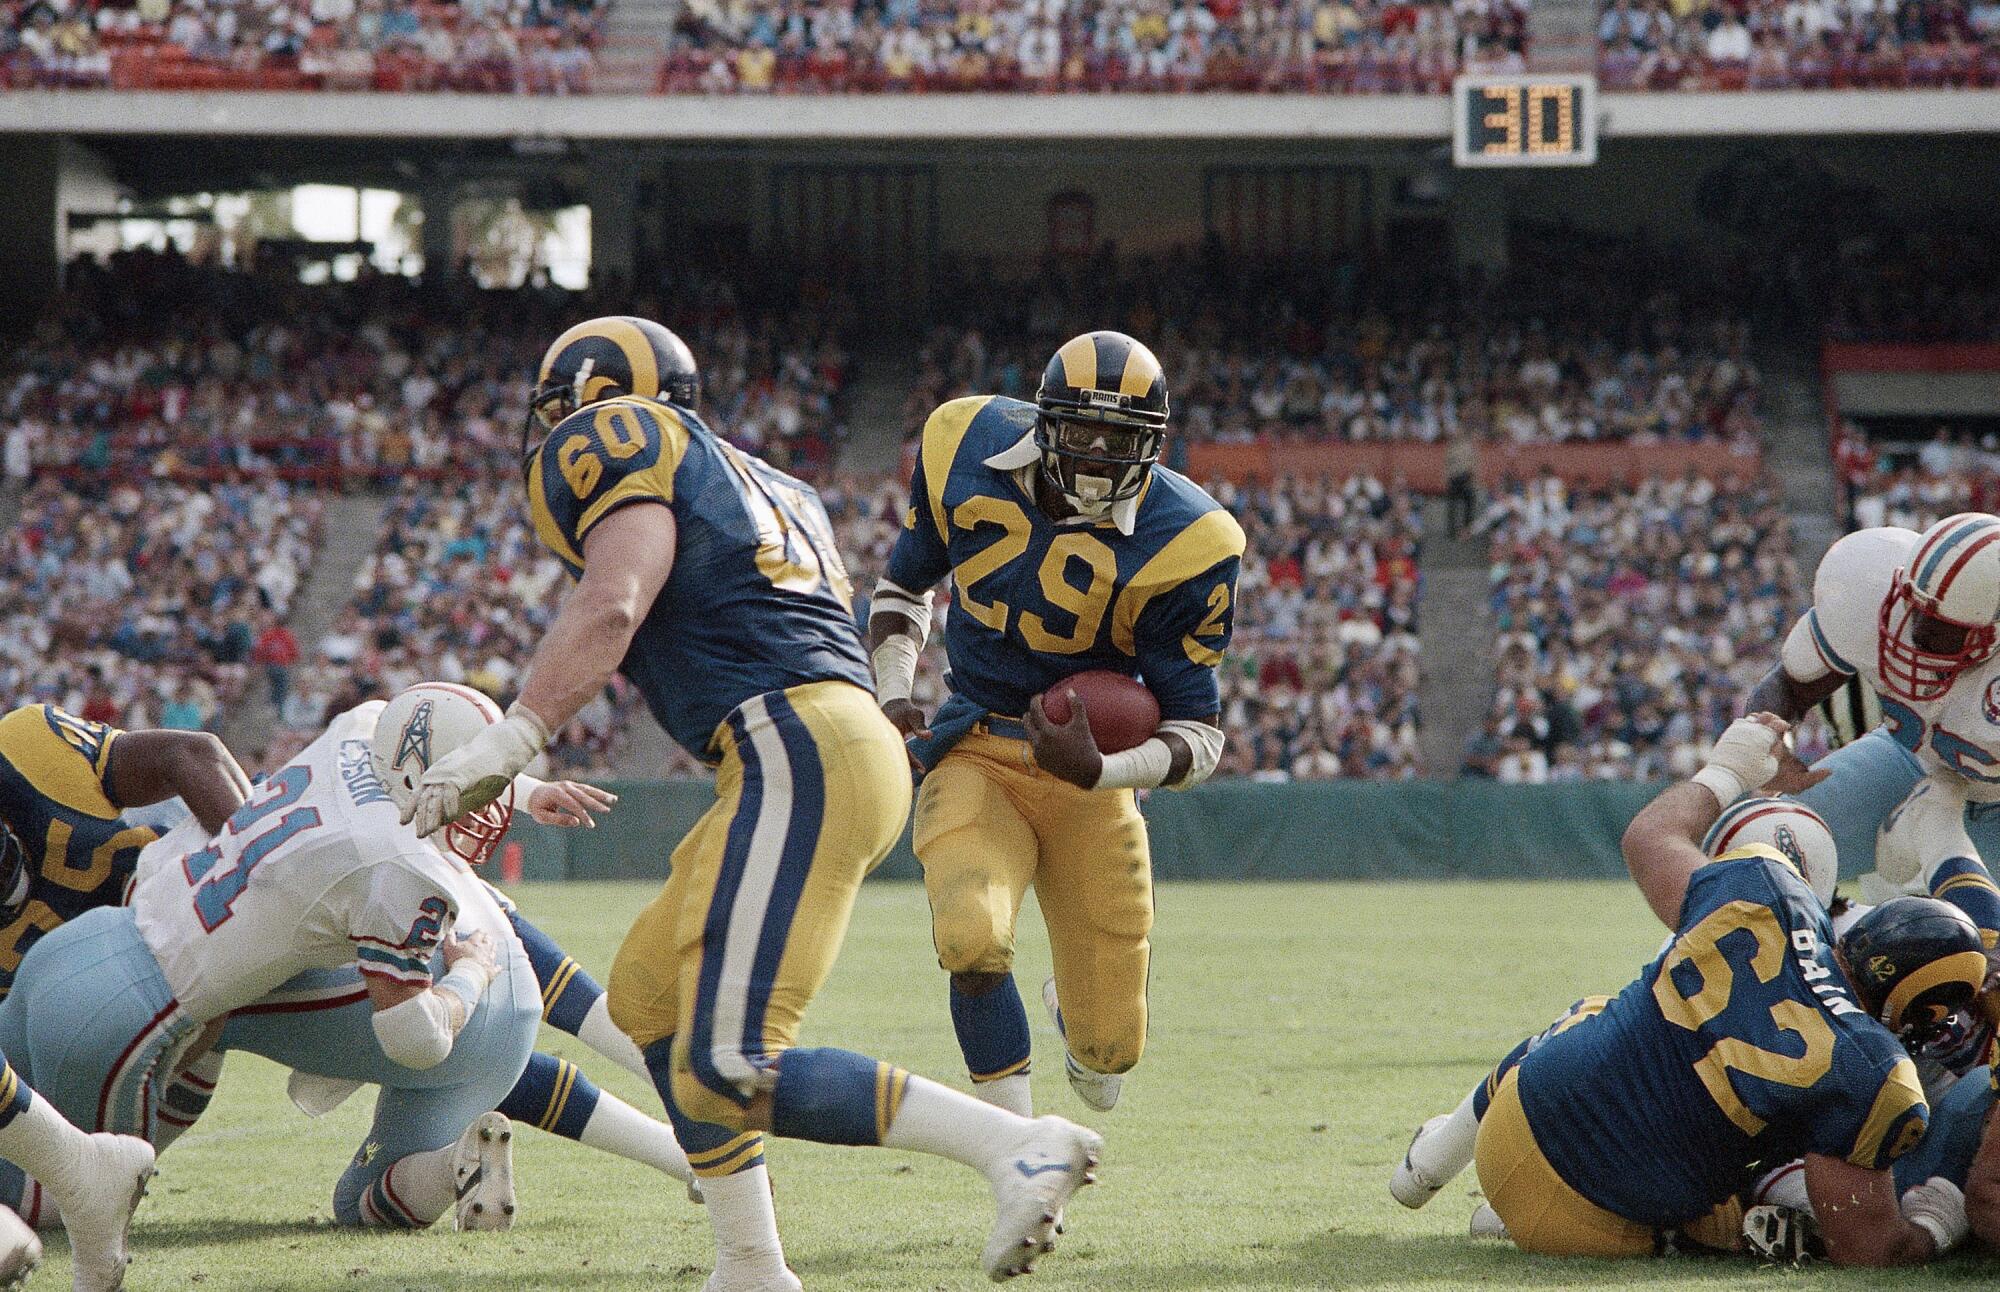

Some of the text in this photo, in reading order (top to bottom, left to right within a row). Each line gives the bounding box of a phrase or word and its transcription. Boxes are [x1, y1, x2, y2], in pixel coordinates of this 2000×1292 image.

[1483, 86, 1574, 156] 30
[1092, 391, 1119, 403] RAMS
[557, 406, 646, 500] 60
[953, 495, 1118, 654] 29
[1652, 900, 1837, 1137] 62
